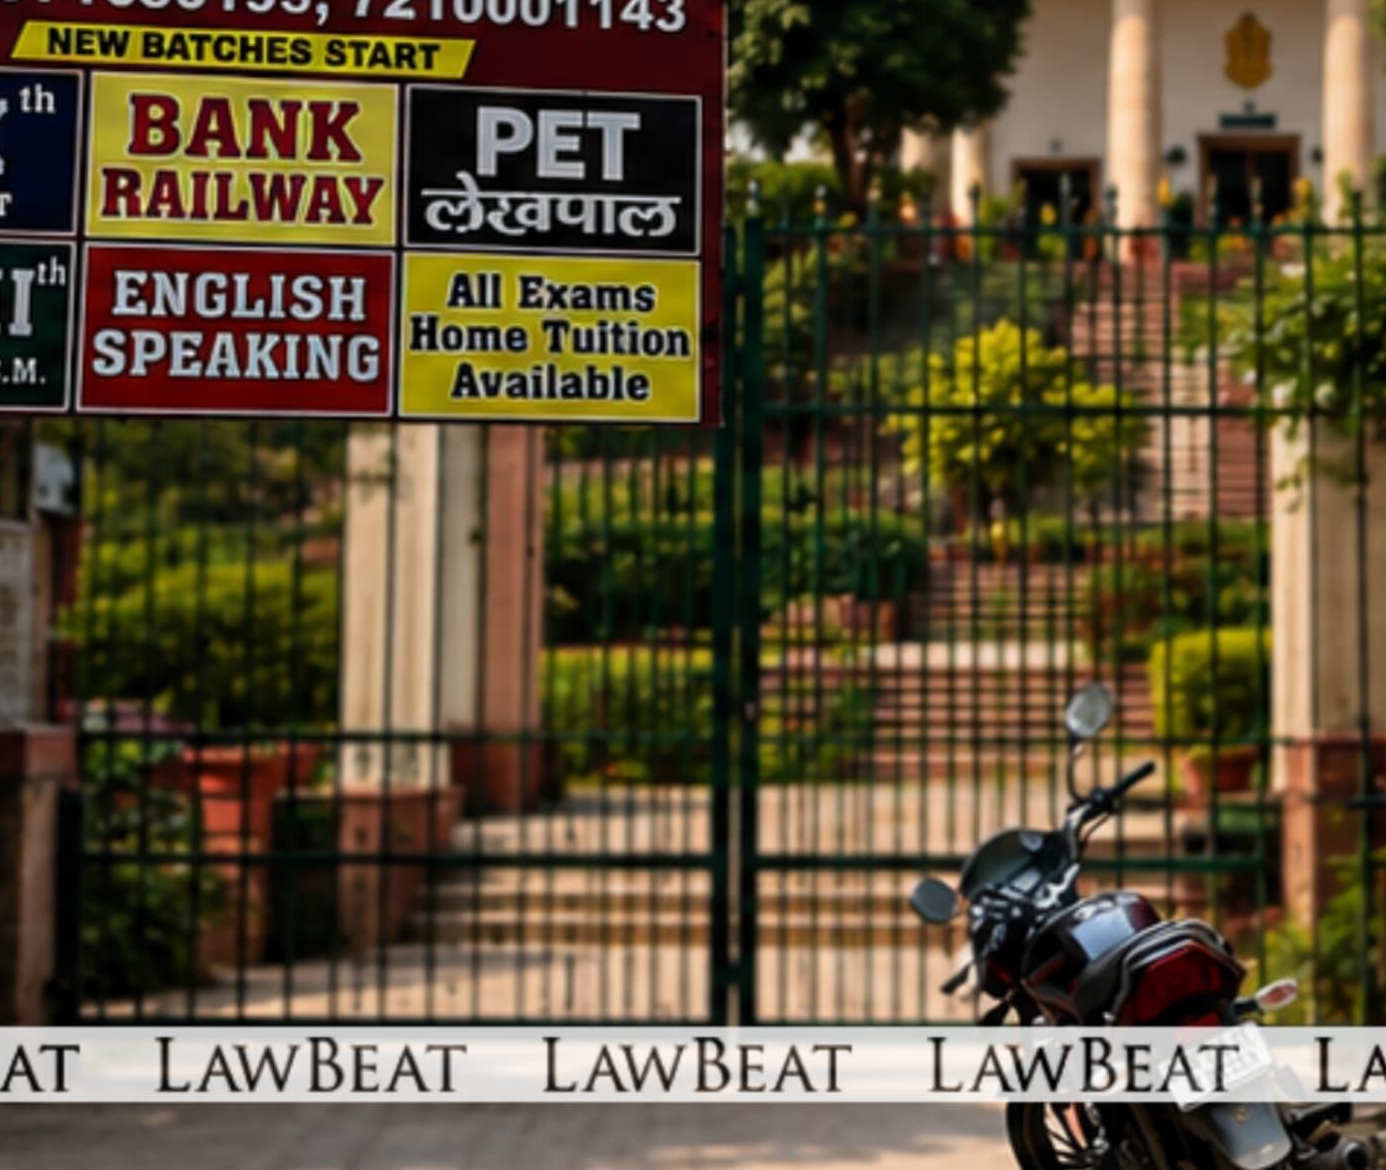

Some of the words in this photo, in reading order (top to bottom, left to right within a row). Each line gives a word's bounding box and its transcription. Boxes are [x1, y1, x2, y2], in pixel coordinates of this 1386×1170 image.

[46, 26, 133, 61] NEW
[141, 30, 315, 68] BATCHES
[324, 36, 441, 71] START
[127, 92, 362, 163] BANK
[476, 106, 641, 181] PET
[100, 166, 385, 225] RAILWAY
[421, 170, 682, 237] लेखपाल
[111, 269, 366, 321] ENGLISH
[447, 273, 501, 309] All
[518, 275, 656, 312] Exams
[92, 329, 380, 382] SPEAKING
[409, 315, 528, 354] Home
[541, 320, 691, 357] Tuition
[451, 363, 650, 401] Available
